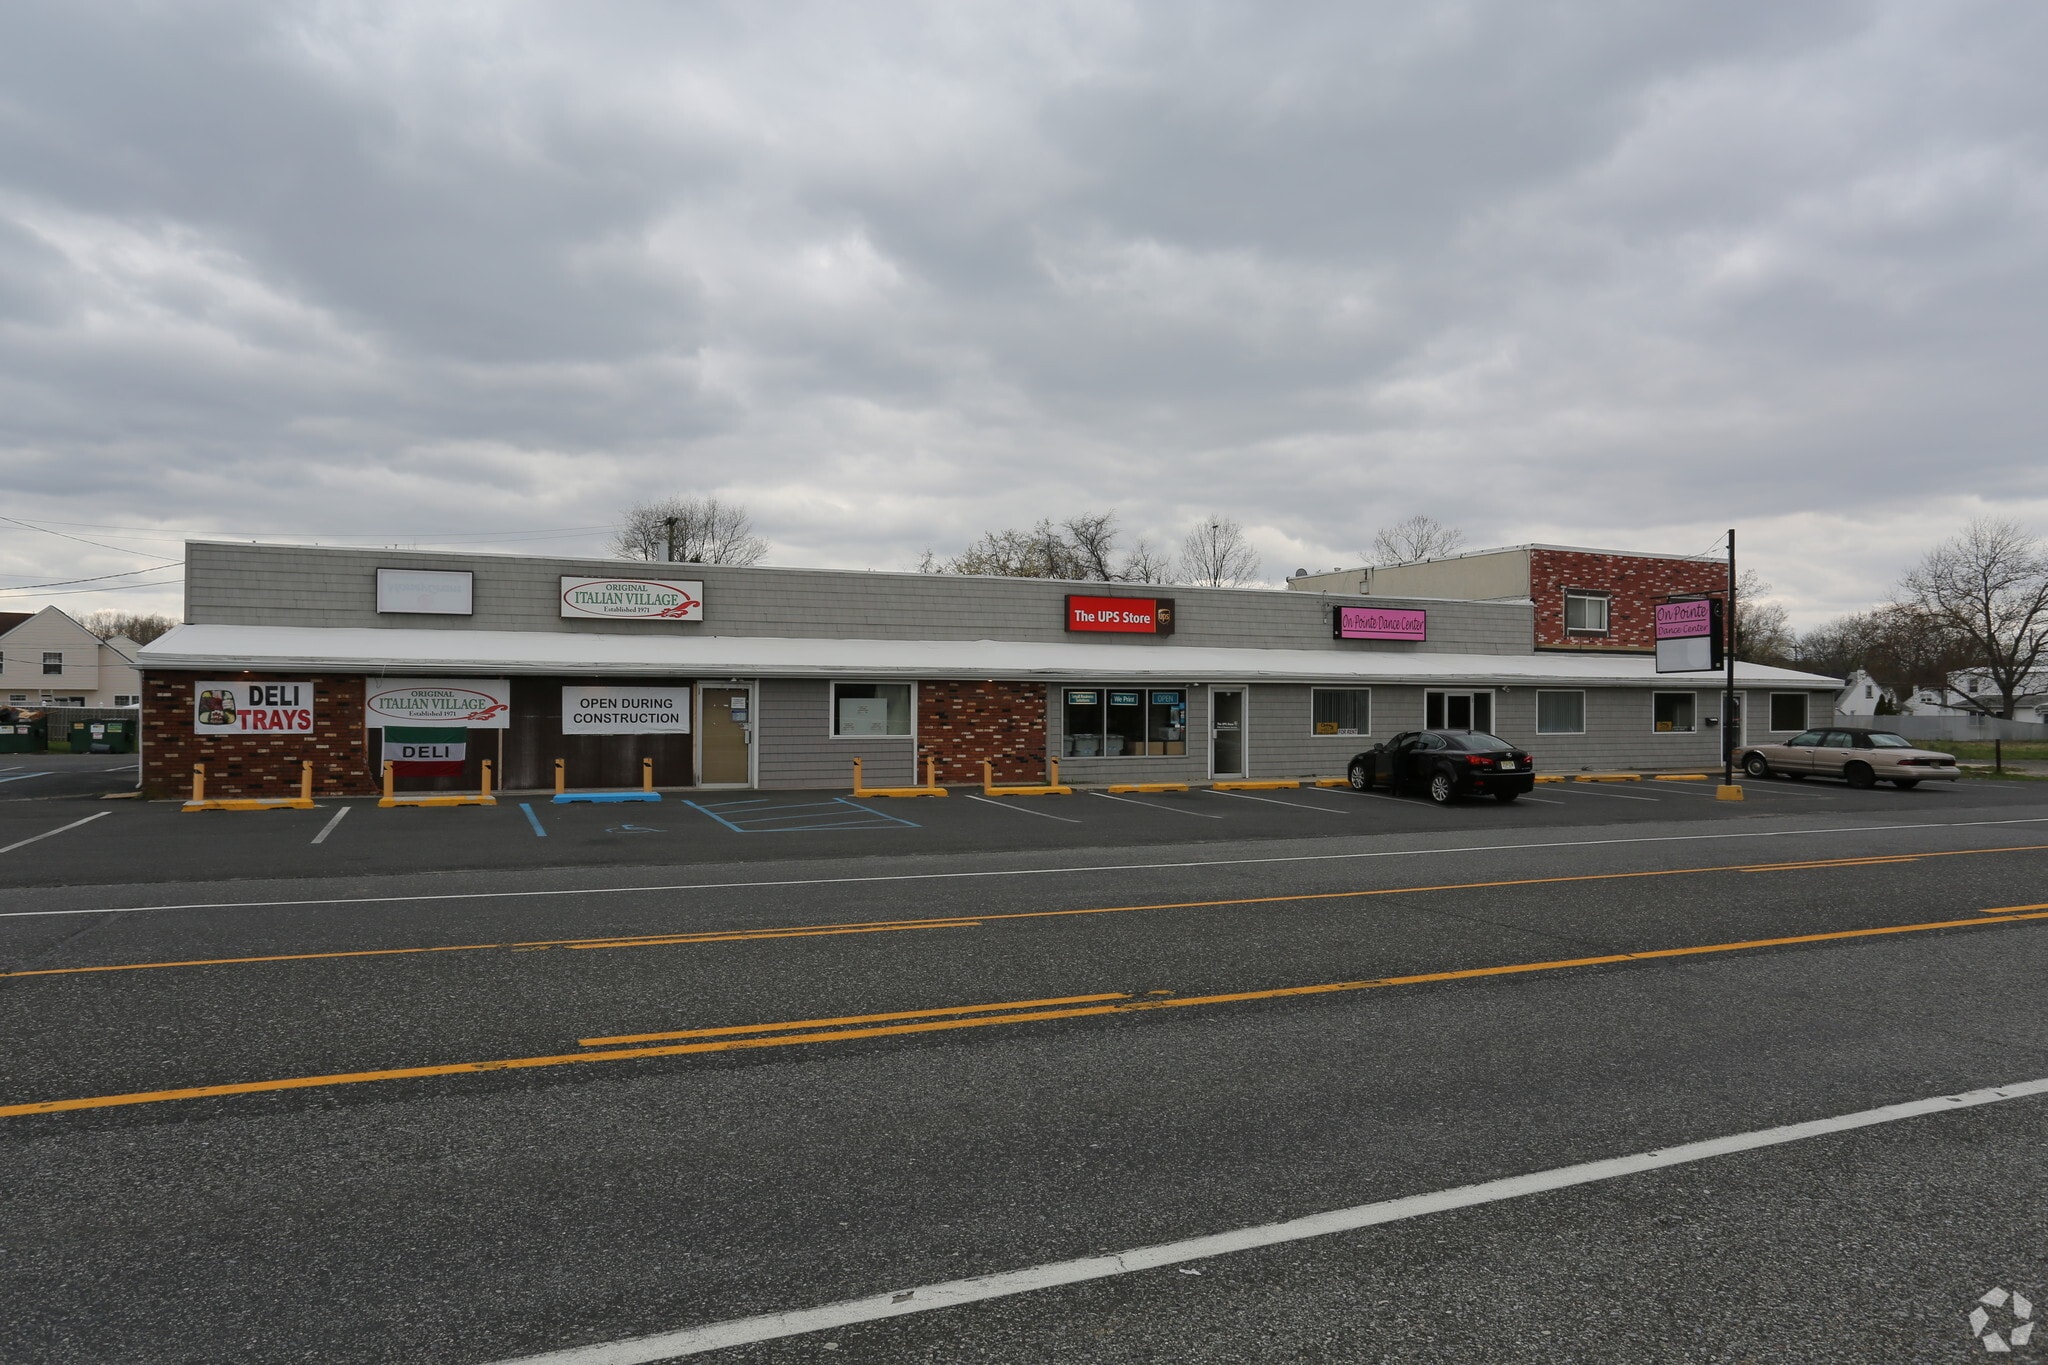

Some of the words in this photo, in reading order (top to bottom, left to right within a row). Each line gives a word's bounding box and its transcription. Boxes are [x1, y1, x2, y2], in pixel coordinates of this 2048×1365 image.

[605, 584, 648, 592] ORIGINAL
[575, 591, 623, 605] ITALIAN
[627, 593, 679, 606] VILLAGE
[1074, 610, 1095, 622] The
[1098, 611, 1120, 623] UPS
[1122, 612, 1150, 623] Store
[1657, 607, 1672, 621] On
[1674, 604, 1707, 620] Pointe
[1343, 614, 1353, 628] On
[1355, 614, 1377, 629] Pointe
[1379, 616, 1400, 631] Dance
[1402, 617, 1424, 630] Center
[1658, 626, 1681, 636] Dance
[1683, 624, 1708, 633] Center
[249, 685, 299, 706] DELI
[411, 690, 455, 698] ORIGINAL
[379, 698, 429, 710] ITALIAN
[431, 699, 486, 710] VILLAGE
[580, 698, 617, 709] OPEN
[621, 698, 673, 709] DURING
[237, 709, 311, 731] TRAYS
[573, 713, 679, 724] CONSTRUCTION
[402, 746, 449, 758] DELI
